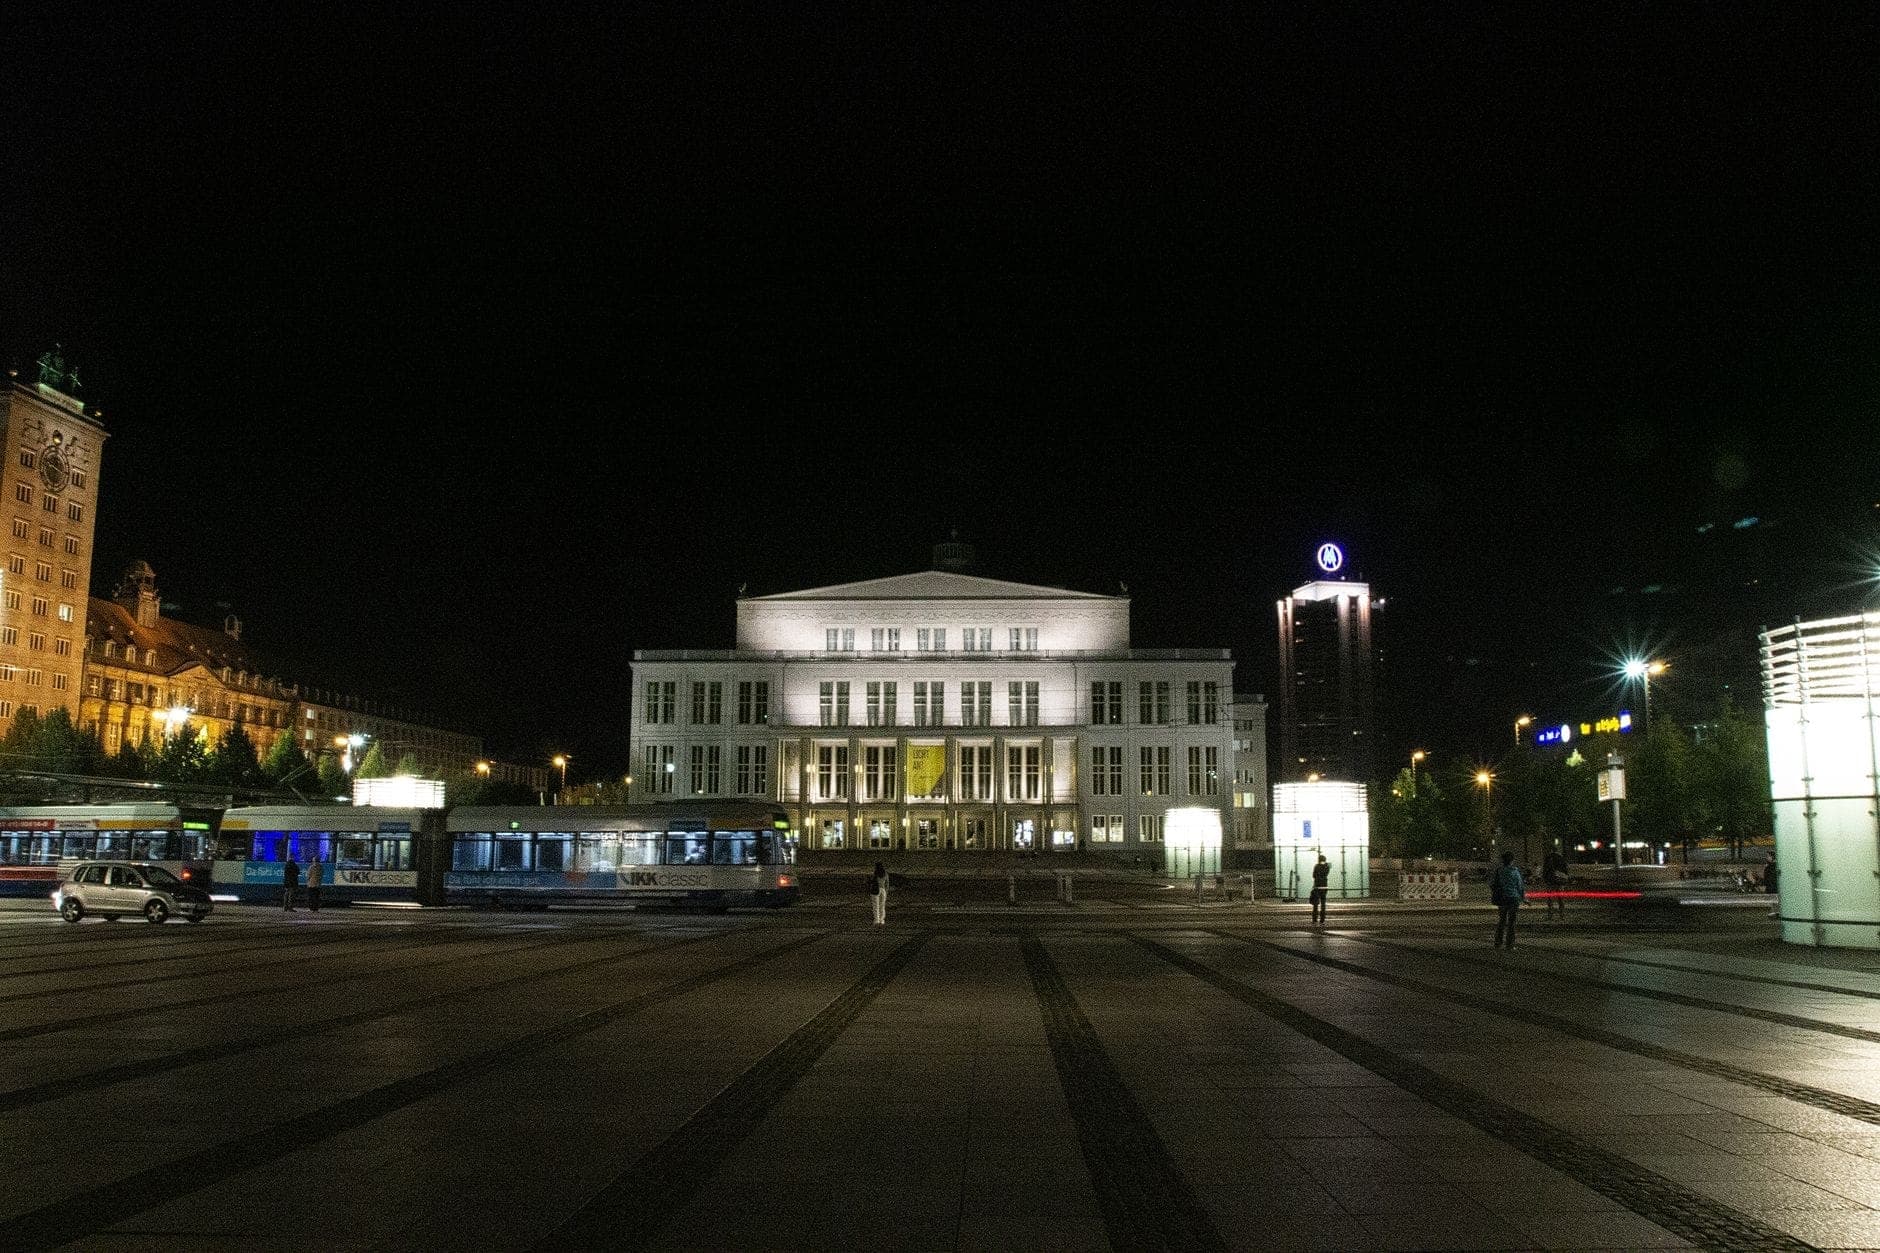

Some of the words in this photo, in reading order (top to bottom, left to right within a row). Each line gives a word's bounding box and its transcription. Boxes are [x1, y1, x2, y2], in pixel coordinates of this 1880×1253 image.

[349, 871, 370, 884] IKK
[631, 872, 658, 886] IKK
[658, 871, 709, 887] classic
